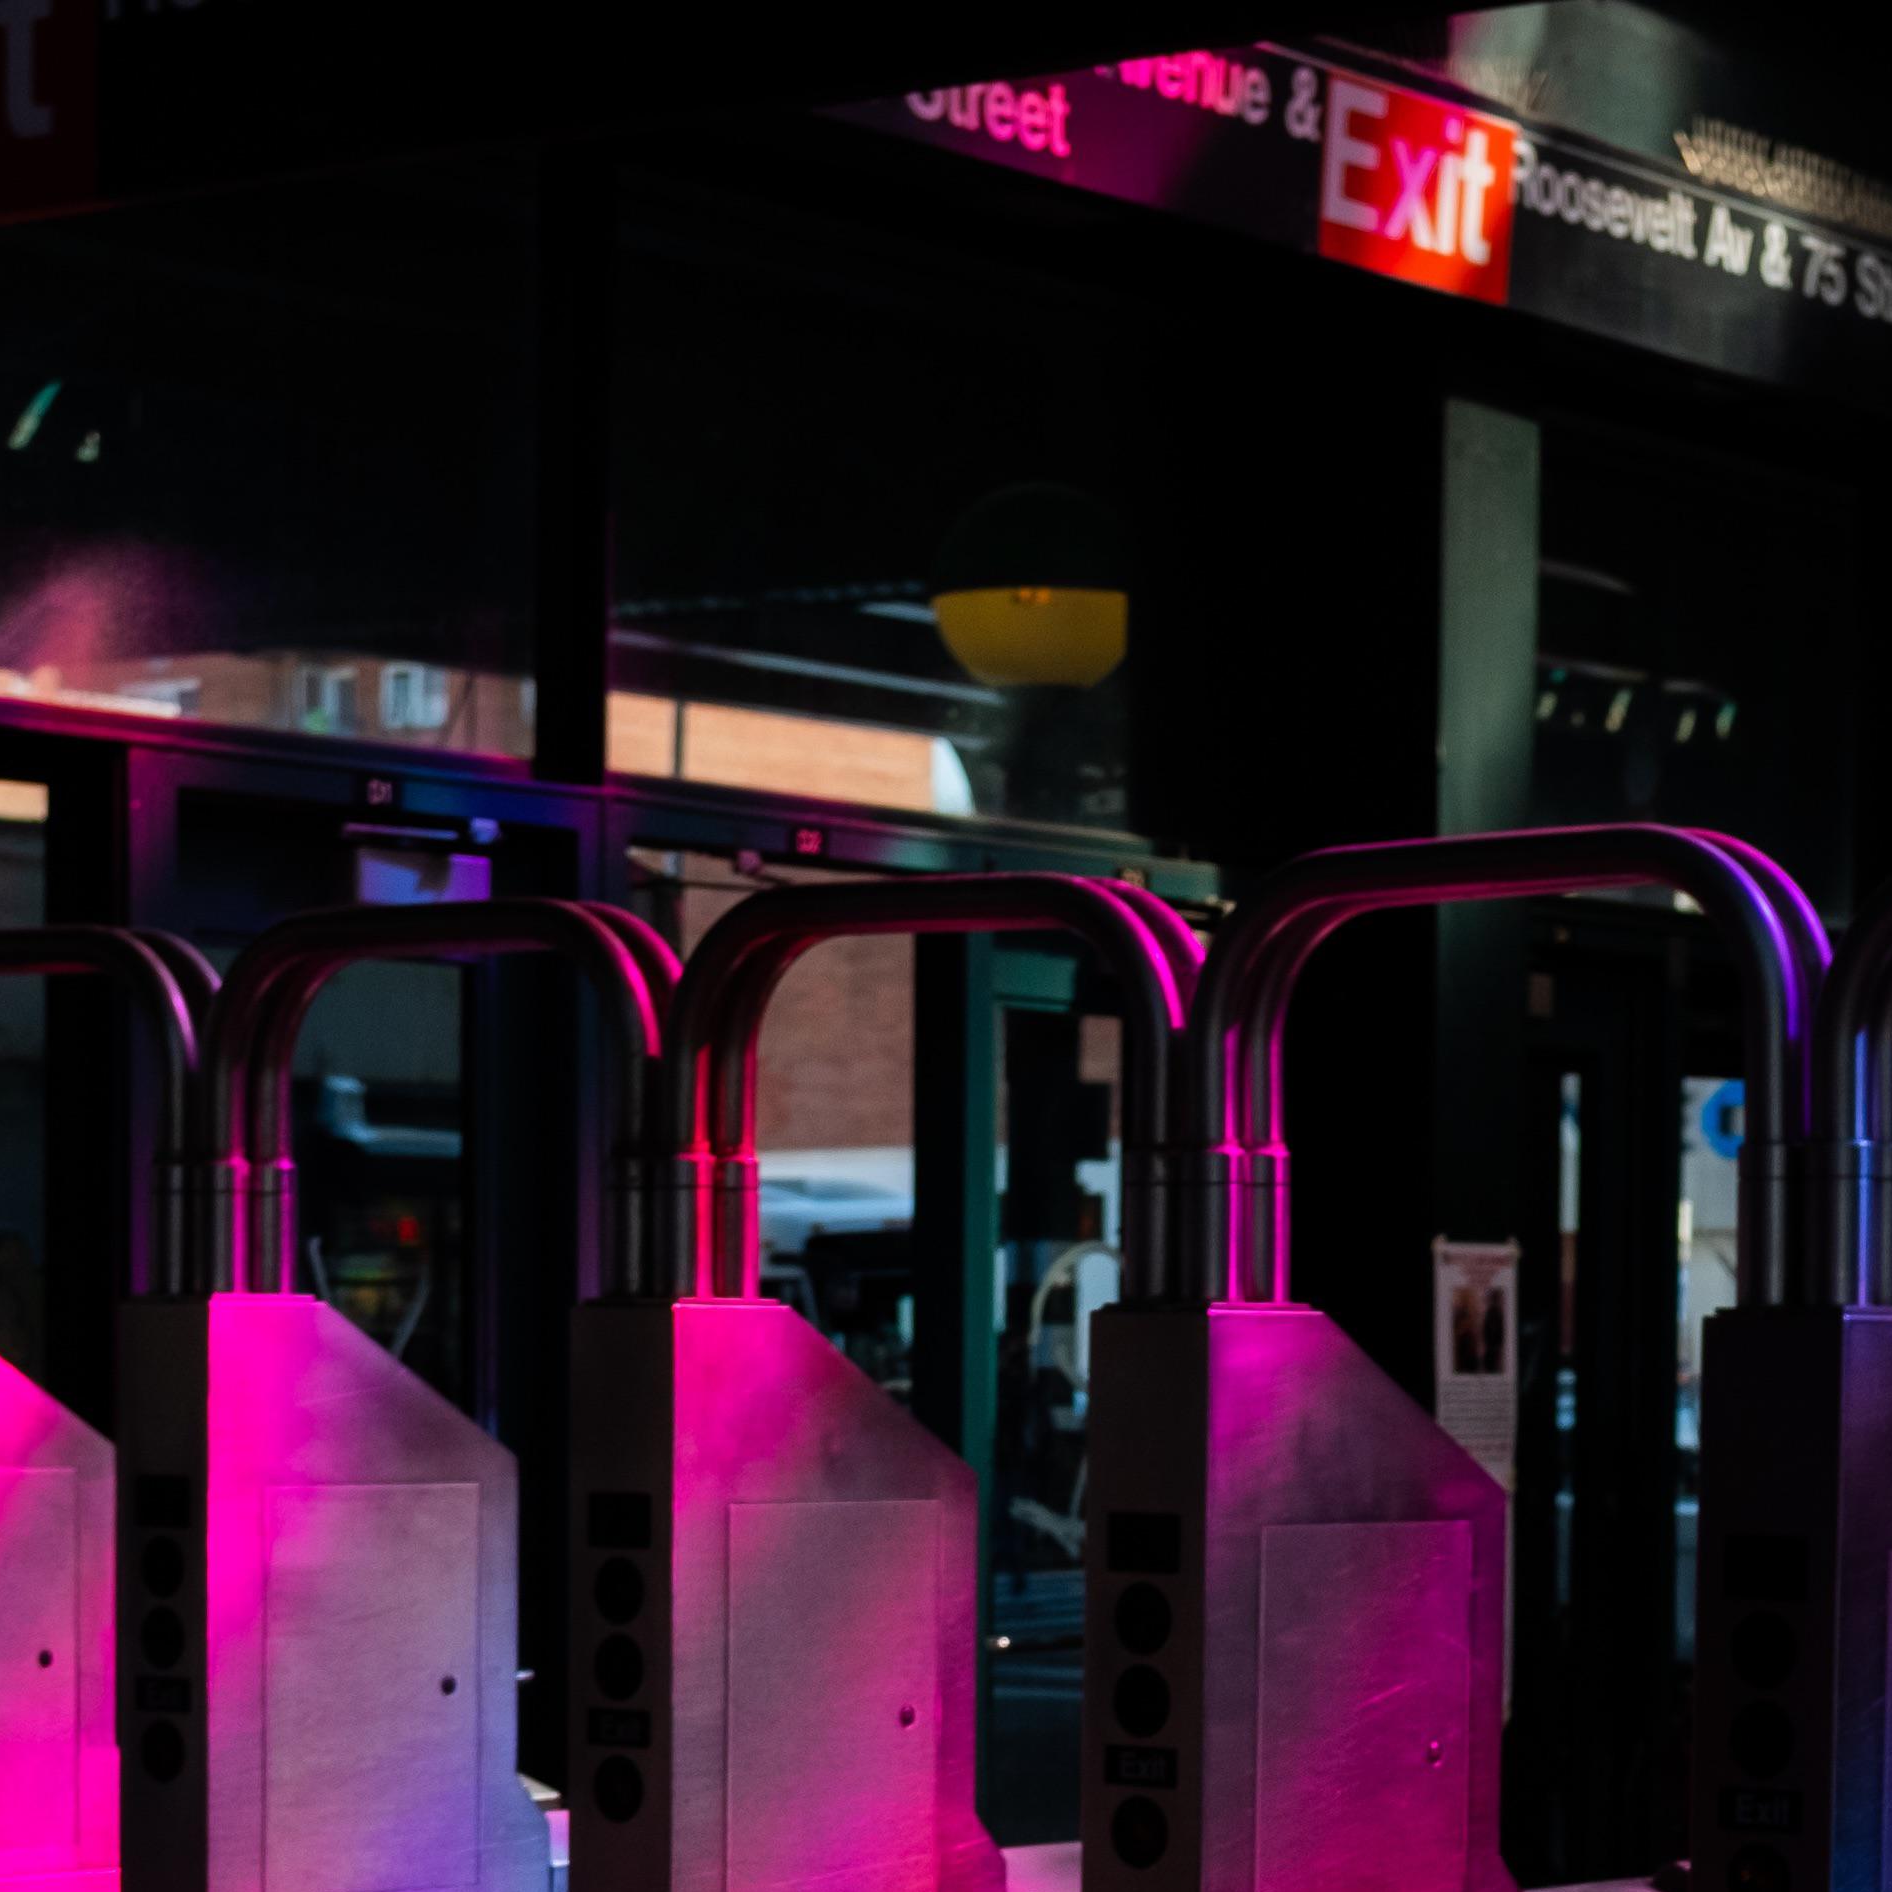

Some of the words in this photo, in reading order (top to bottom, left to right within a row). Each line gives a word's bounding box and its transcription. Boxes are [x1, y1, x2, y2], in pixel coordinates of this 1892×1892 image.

[1094, 48, 1273, 127] venue
[1284, 66, 1323, 143] &
[1321, 78, 1497, 268] Exit
[1510, 137, 1698, 260] Roosevelt
[1704, 203, 1754, 276] Av
[1760, 221, 1793, 290] &
[1799, 231, 1848, 307] 75
